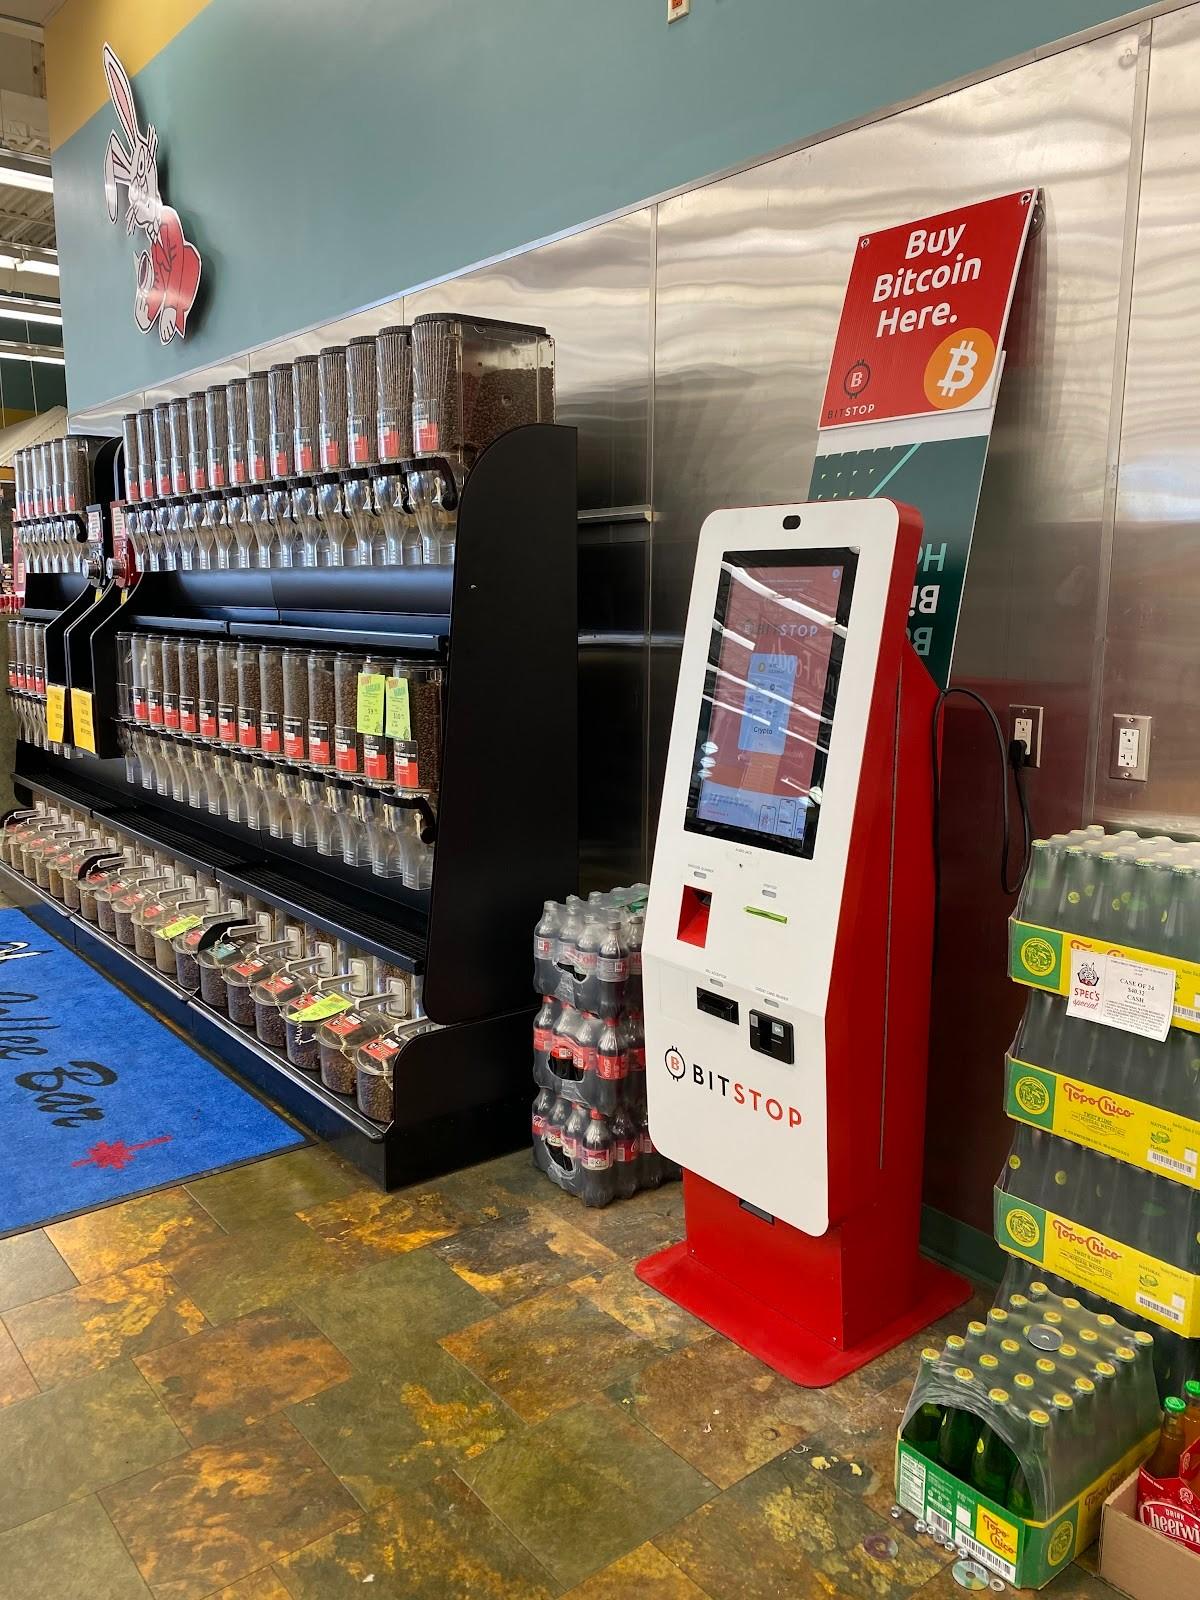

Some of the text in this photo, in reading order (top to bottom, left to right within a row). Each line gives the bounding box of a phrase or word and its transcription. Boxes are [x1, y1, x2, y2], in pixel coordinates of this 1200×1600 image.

[905, 223, 966, 259] Buy
[872, 252, 982, 303] Bitcoin
[876, 302, 958, 338] Here.
[827, 402, 876, 420] BITSTOP
[753, 726, 773, 736] Crypto
[1074, 987, 1101, 1001] SPEC'S
[1120, 978, 1137, 987] CASE
[1126, 994, 1145, 1003] CASH
[14, 1060, 118, 1128] Bar
[693, 1063, 803, 1129] BITSTOP
[1063, 1082, 1134, 1118] Topo Chico
[1052, 1219, 1122, 1261] Topo Chico
[983, 1514, 1009, 1538] Topo
[1165, 1508, 1186, 1521] DRINK
[990, 1532, 1018, 1554] Chico
